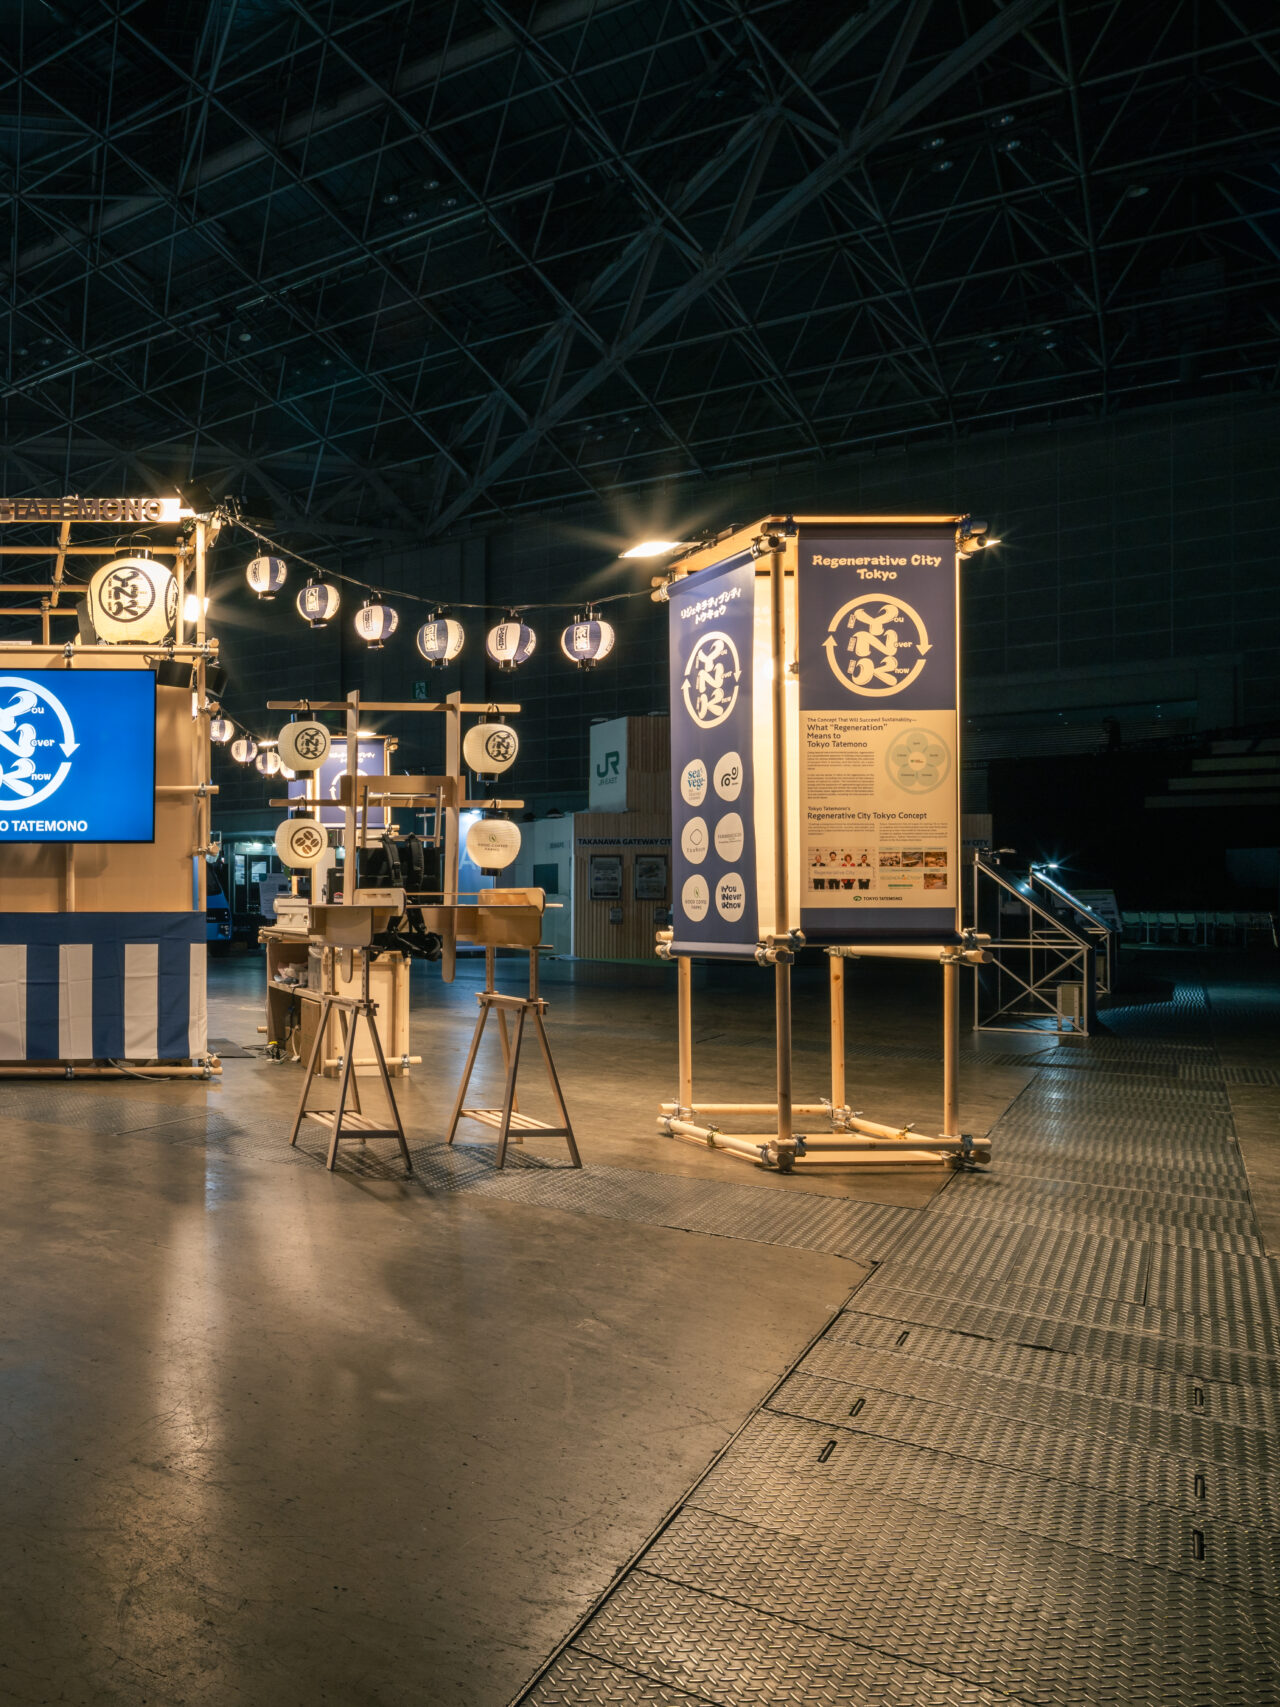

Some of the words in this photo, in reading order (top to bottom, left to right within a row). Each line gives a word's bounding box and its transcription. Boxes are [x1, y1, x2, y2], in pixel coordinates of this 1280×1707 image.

[13, 498, 164, 522] TATEMONO
[812, 554, 907, 569] Regenerative
[910, 554, 942, 567] City
[856, 568, 898, 582] Tokyo
[807, 740, 830, 749] Tokyo
[832, 740, 868, 748] Tatemono
[596, 751, 620, 778] JR
[807, 812, 856, 820] Regenerative
[857, 812, 871, 820] City
[872, 812, 896, 820] Tokyo
[898, 812, 928, 820] Concept
[11, 819, 88, 833] TATEMONO
[578, 838, 621, 846] TAKANAWA
[659, 838, 672, 846] CIT
